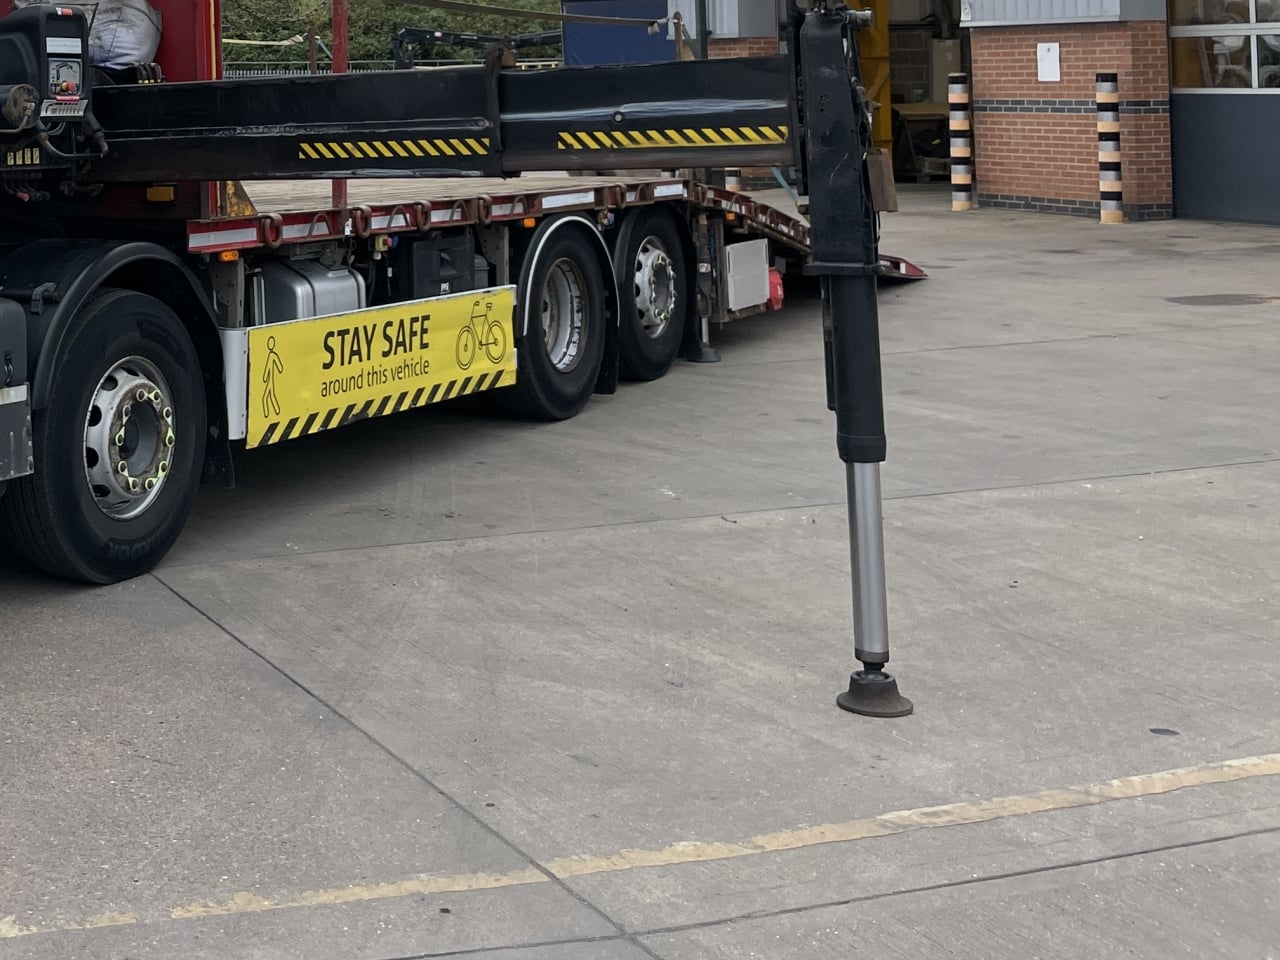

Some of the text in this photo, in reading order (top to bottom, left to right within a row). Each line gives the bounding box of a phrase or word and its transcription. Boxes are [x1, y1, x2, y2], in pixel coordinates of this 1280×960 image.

[322, 314, 431, 370] STAY SAFE
[321, 355, 430, 397] around this vehicle
